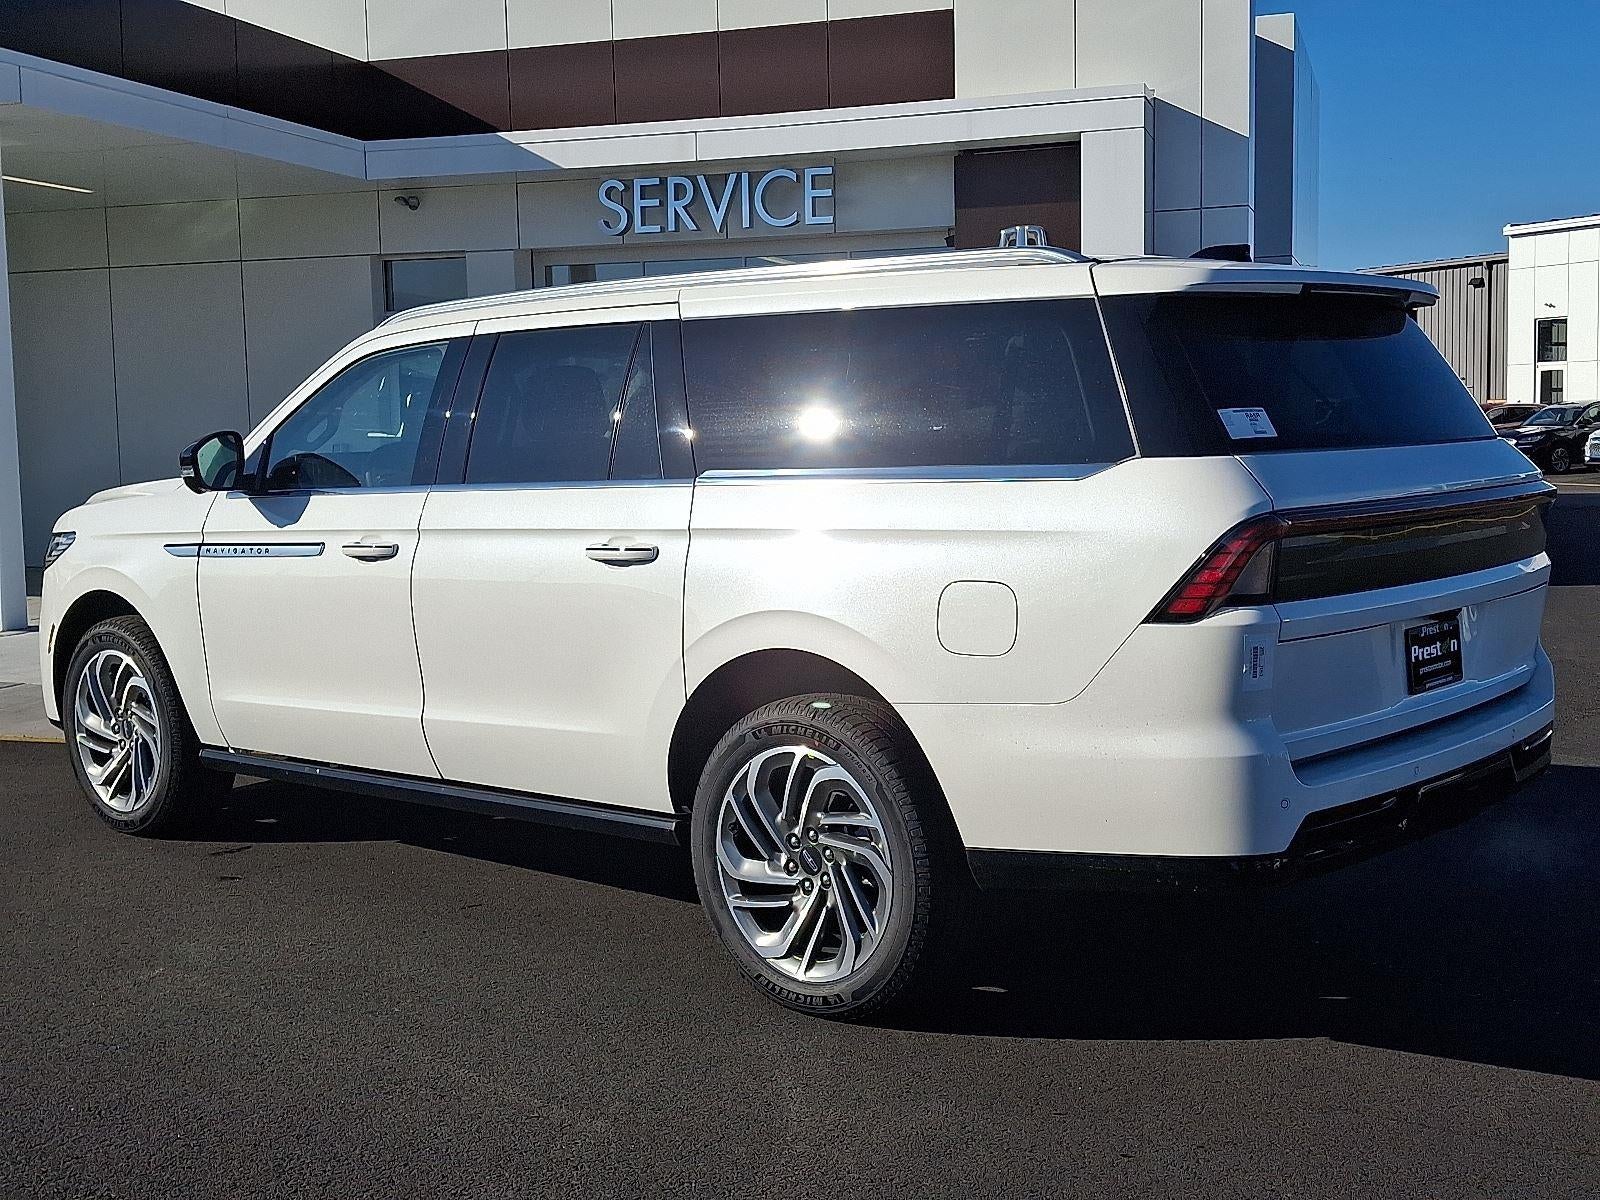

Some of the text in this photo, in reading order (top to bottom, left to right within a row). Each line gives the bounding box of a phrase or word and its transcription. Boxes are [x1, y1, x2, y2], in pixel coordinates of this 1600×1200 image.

[598, 166, 834, 236] SERVICE
[205, 547, 270, 555] NAVIGATOR
[1421, 623, 1449, 637] Prestn
[771, 725, 838, 750] MICHELIN
[758, 974, 823, 1006] MICHELIN
